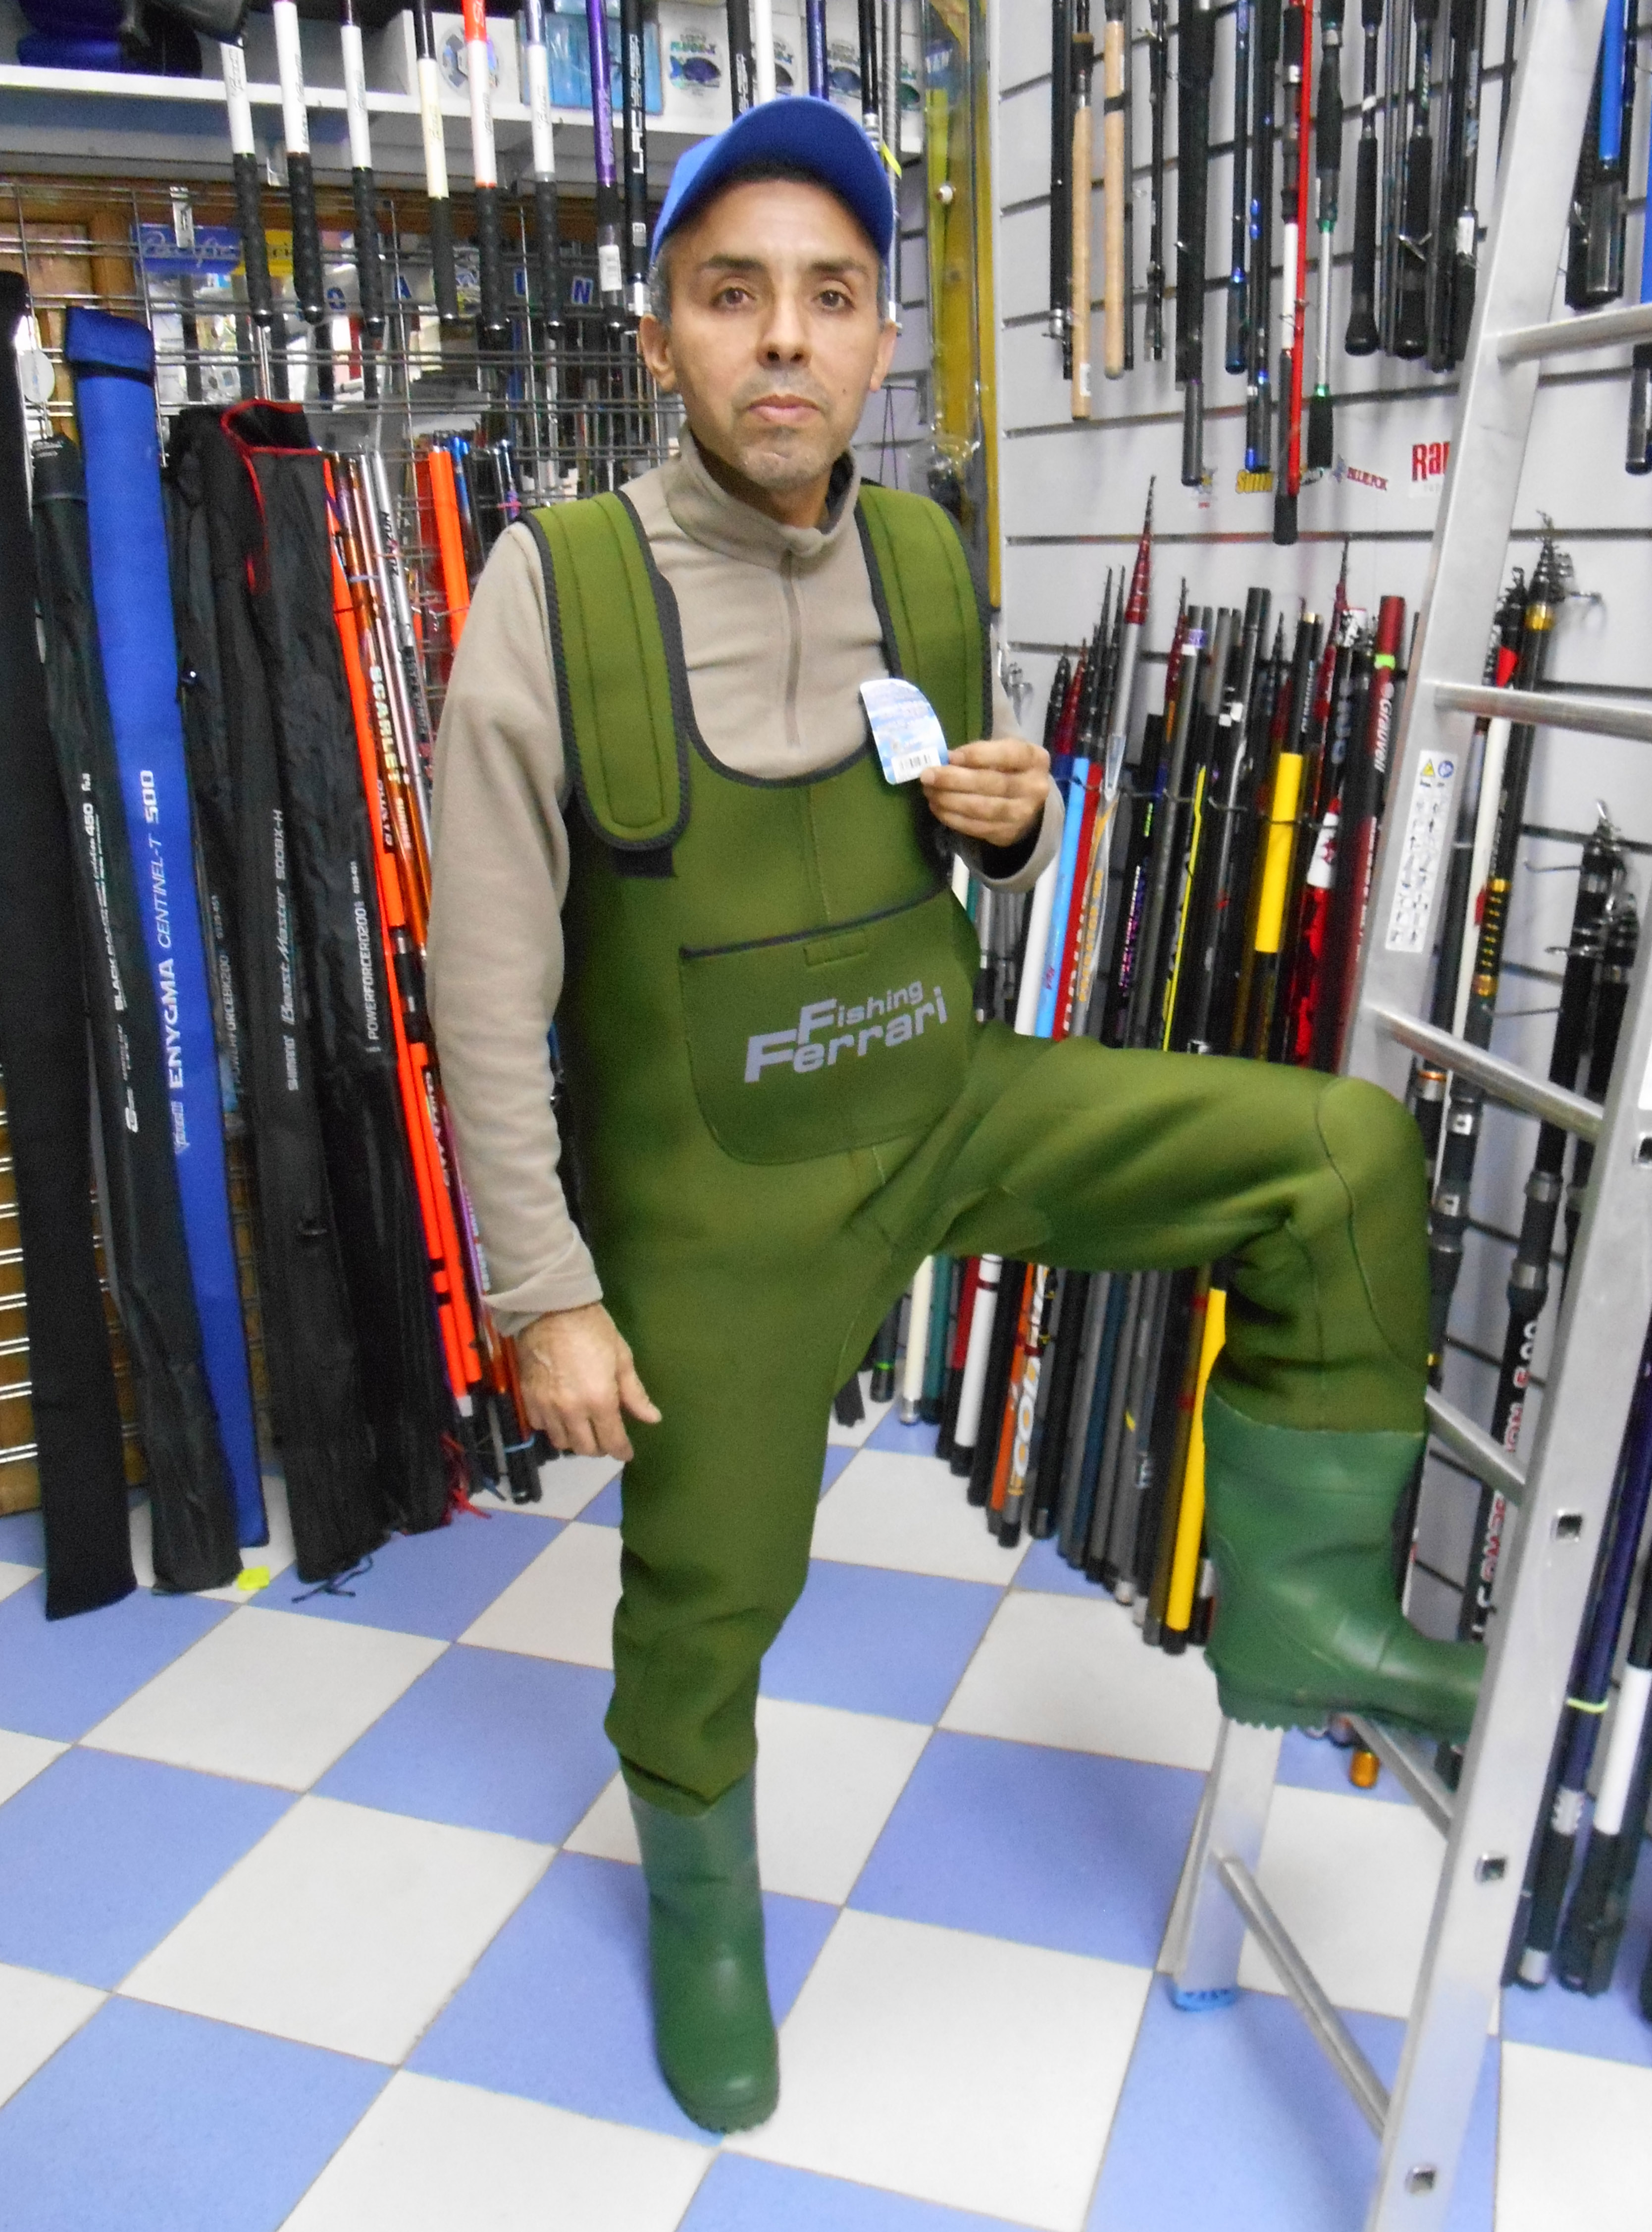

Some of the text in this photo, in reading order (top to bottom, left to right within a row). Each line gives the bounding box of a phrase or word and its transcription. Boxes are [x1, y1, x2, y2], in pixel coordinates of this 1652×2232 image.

[369, 666, 403, 784] SCARLET
[1374, 701, 1393, 773] Grauvell
[140, 770, 159, 824] 500
[148, 834, 172, 949] CENTINEL-T
[158, 958, 184, 1089] ENYGMA
[744, 985, 948, 1084] Ferrari
[797, 979, 925, 1046] Fishing
